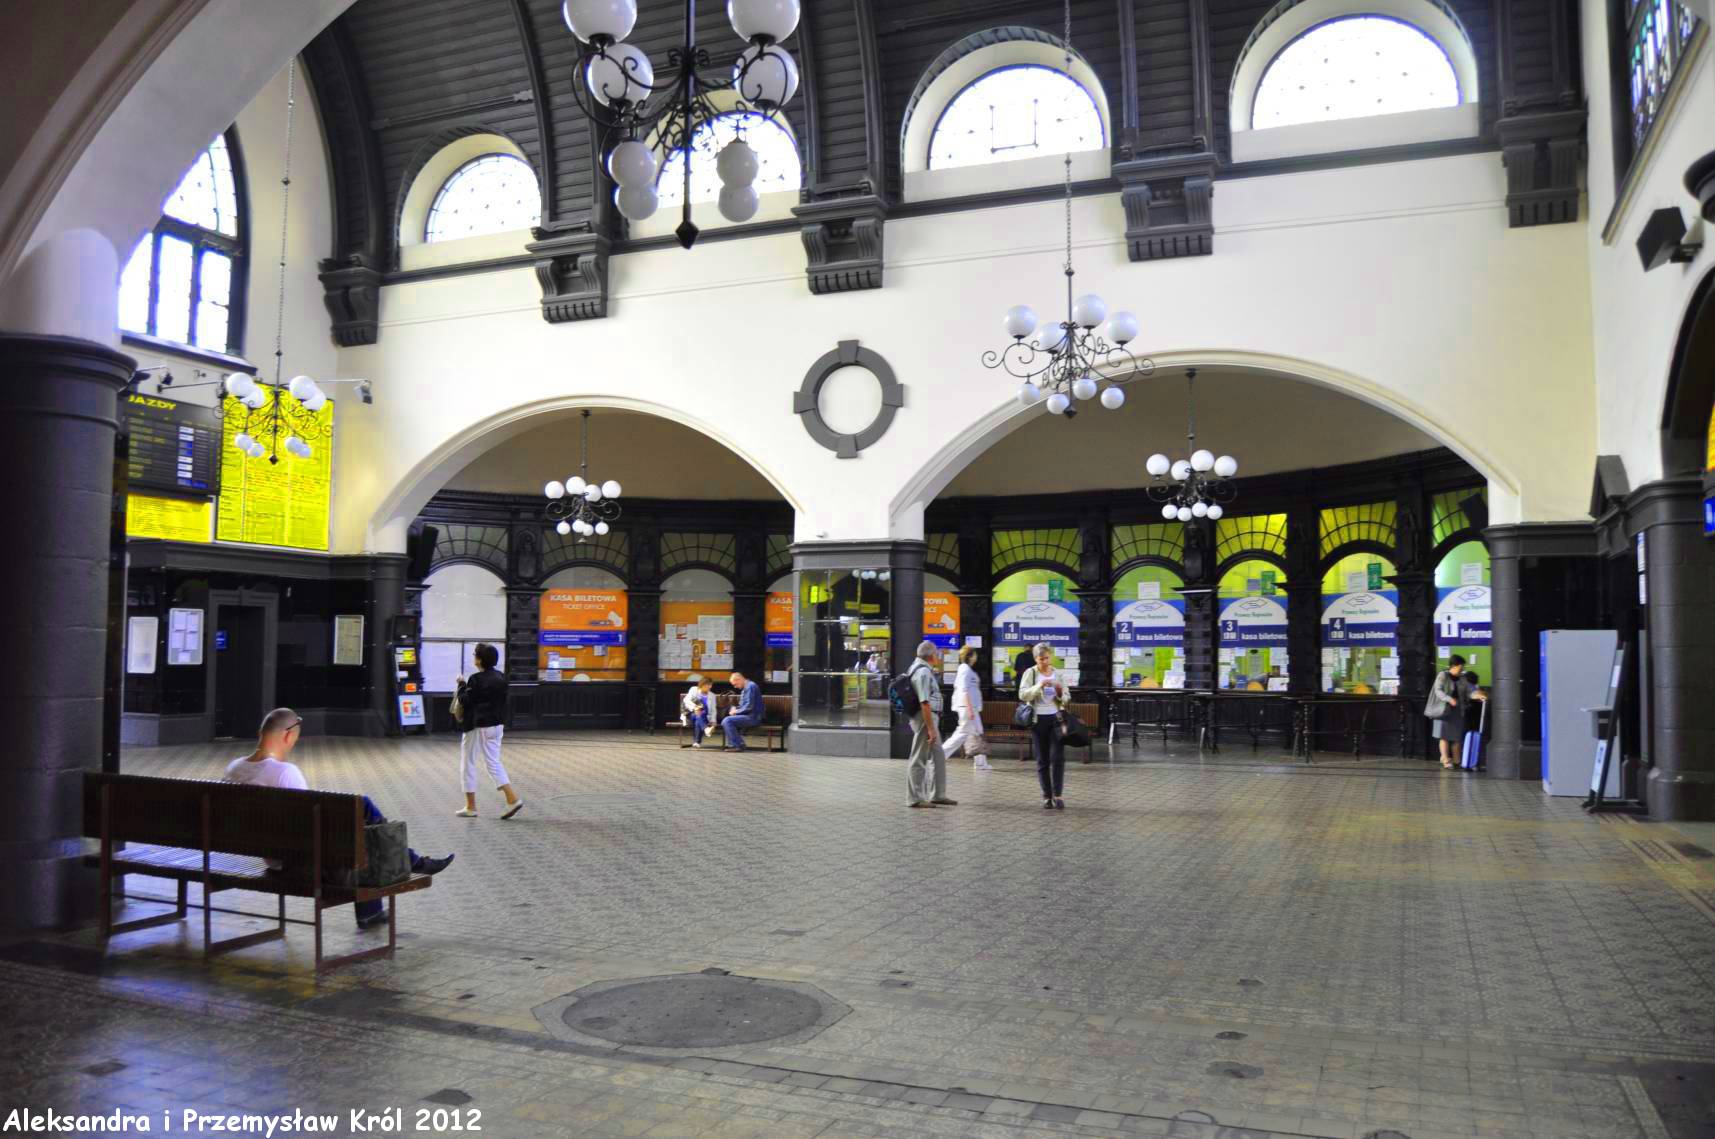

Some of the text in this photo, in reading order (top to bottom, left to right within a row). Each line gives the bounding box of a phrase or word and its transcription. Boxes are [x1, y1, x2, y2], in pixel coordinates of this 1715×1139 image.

[550, 594, 617, 602] KASA BILETOWA
[1008, 623, 1015, 633] 1
[1121, 622, 1129, 633] 2
[1226, 620, 1233, 632] 3
[1333, 618, 1342, 631] 4
[1022, 633, 1070, 641] kasa biletowa
[1135, 633, 1153, 641] kasa
[1241, 632, 1258, 640] kasa
[1348, 631, 1395, 639] kasa biletowa
